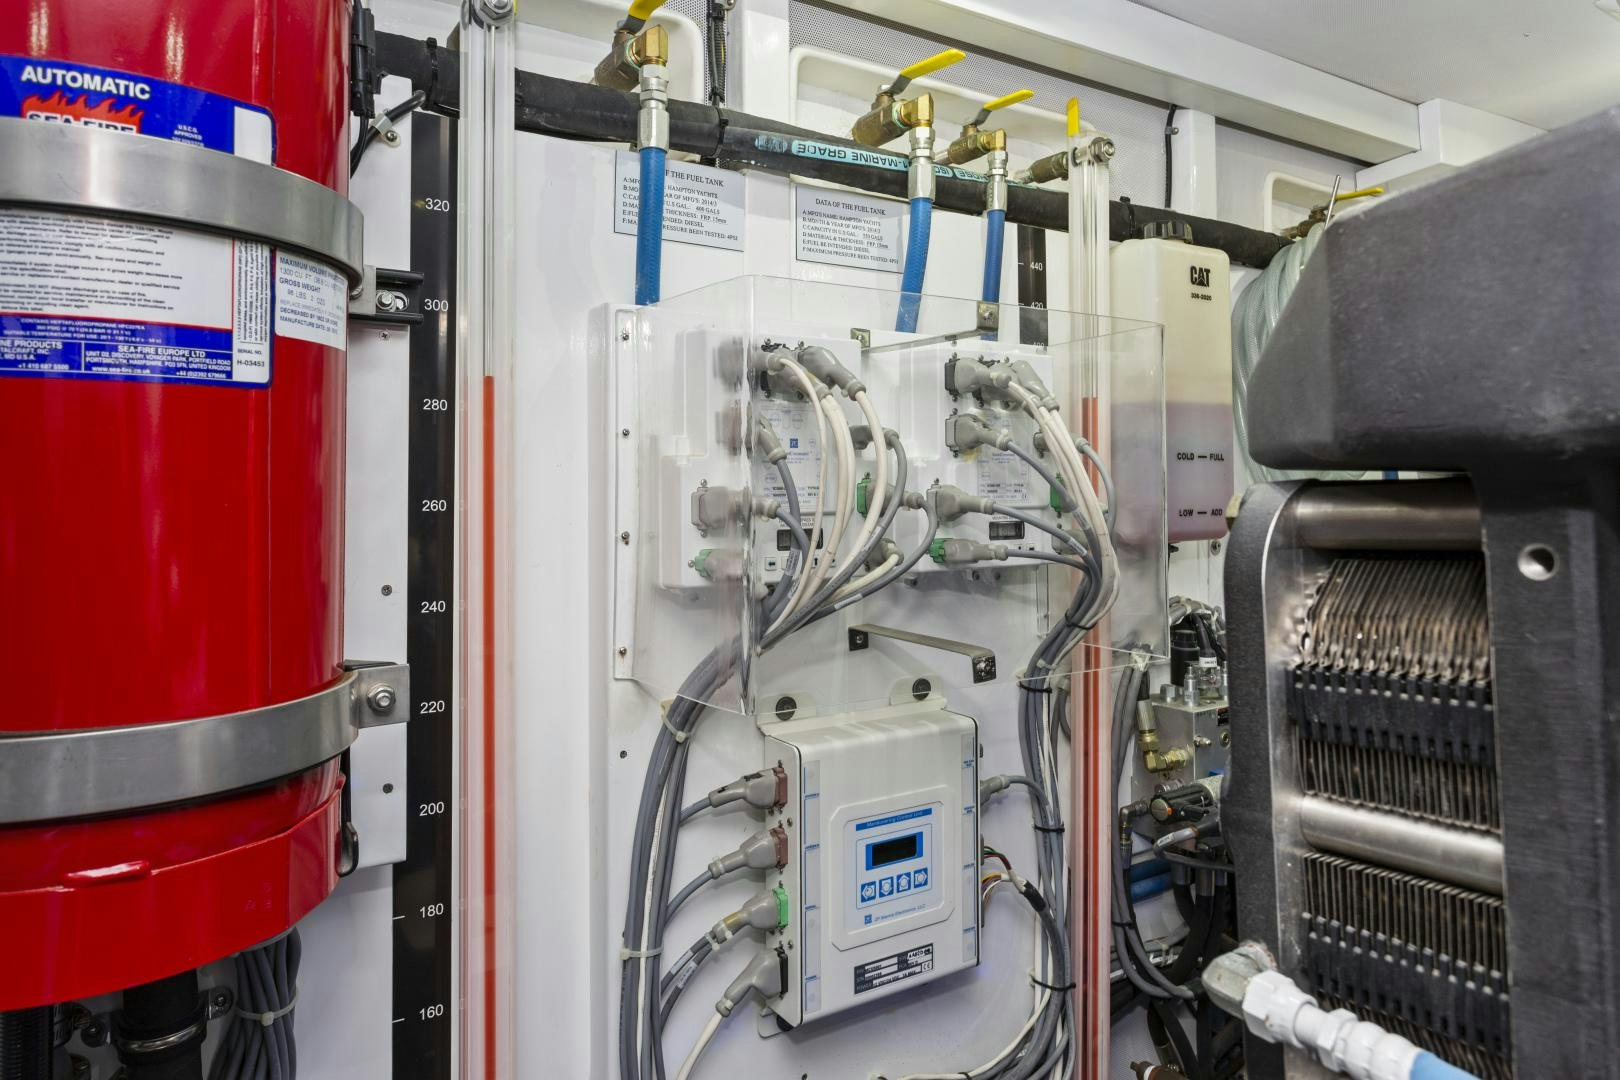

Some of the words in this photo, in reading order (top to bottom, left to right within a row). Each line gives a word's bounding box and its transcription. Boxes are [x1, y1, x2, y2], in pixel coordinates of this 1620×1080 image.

[21, 65, 150, 99] AUTOMATIC
[670, 170, 684, 180] THE
[686, 173, 704, 184] FUEL
[706, 178, 724, 187] TANK
[424, 198, 450, 212] 320
[816, 198, 831, 207] DATA
[854, 204, 869, 213] FUEL
[870, 207, 886, 216] TANK
[280, 257, 308, 270] MAXIMUM
[1030, 262, 1043, 271] 440
[1190, 266, 1210, 287] CAT
[280, 278, 300, 288] GROSS
[302, 282, 320, 293] WEIGHT
[424, 300, 449, 312] 300
[14, 340, 62, 350] PRODUCTS
[118, 345, 156, 354] SEA-FIRE
[158, 348, 190, 357] EUROPE
[423, 399, 448, 411] 280
[422, 500, 447, 512] 260
[421, 601, 446, 613] 240
[420, 700, 445, 714] 220
[419, 802, 444, 816] 200
[420, 904, 444, 918] 180
[419, 1004, 444, 1020] 160
